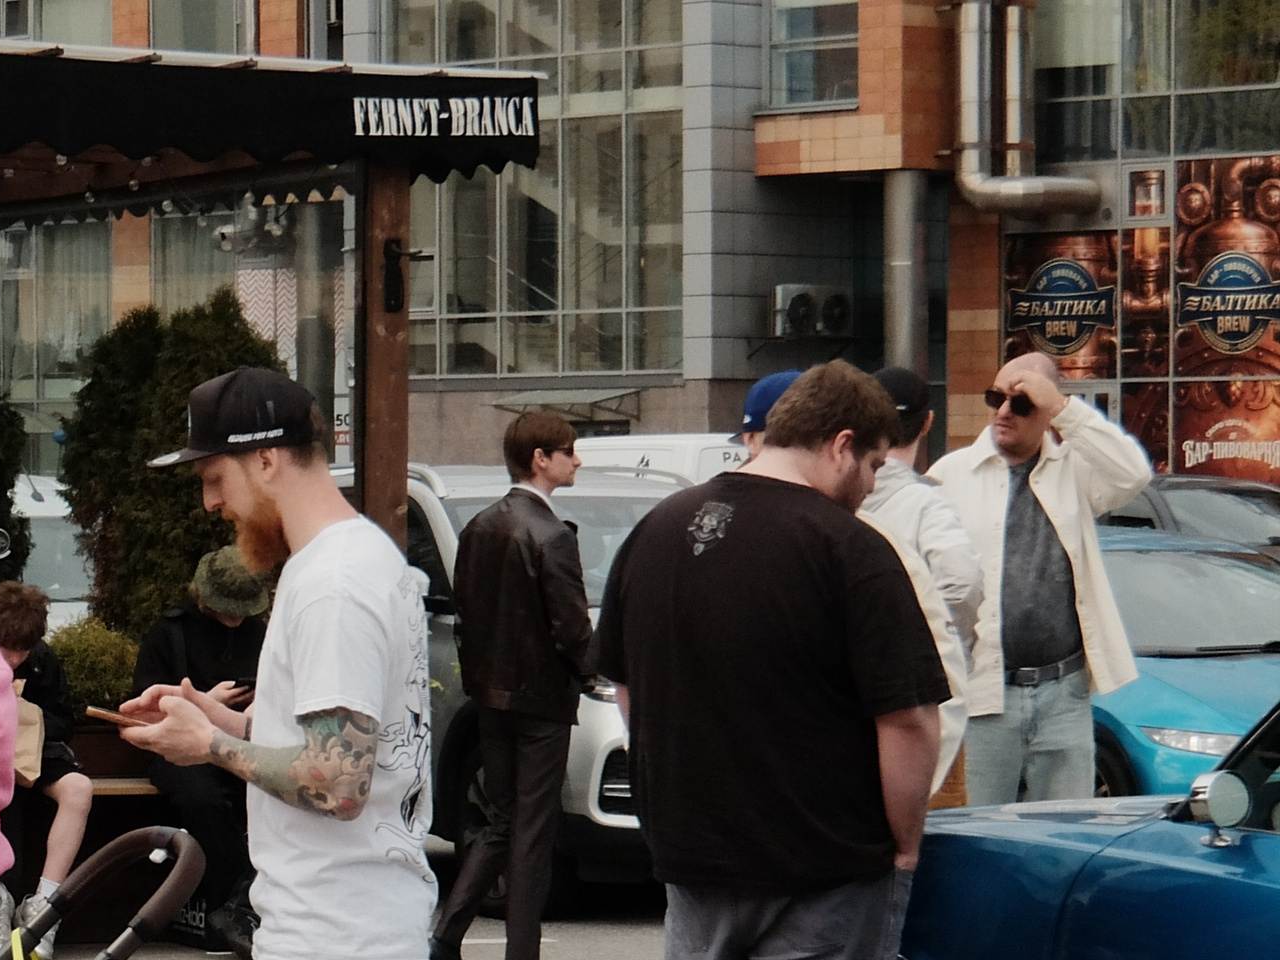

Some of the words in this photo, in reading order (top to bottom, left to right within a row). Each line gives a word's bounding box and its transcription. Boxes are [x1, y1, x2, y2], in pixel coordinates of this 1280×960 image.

[353, 97, 535, 136] FERNET-BRANCA
[1029, 300, 1107, 316] БАЛТИКА
[1200, 294, 1280, 311] БАЛТИКА
[1045, 321, 1077, 338] BREW
[1216, 316, 1250, 334] BREW
